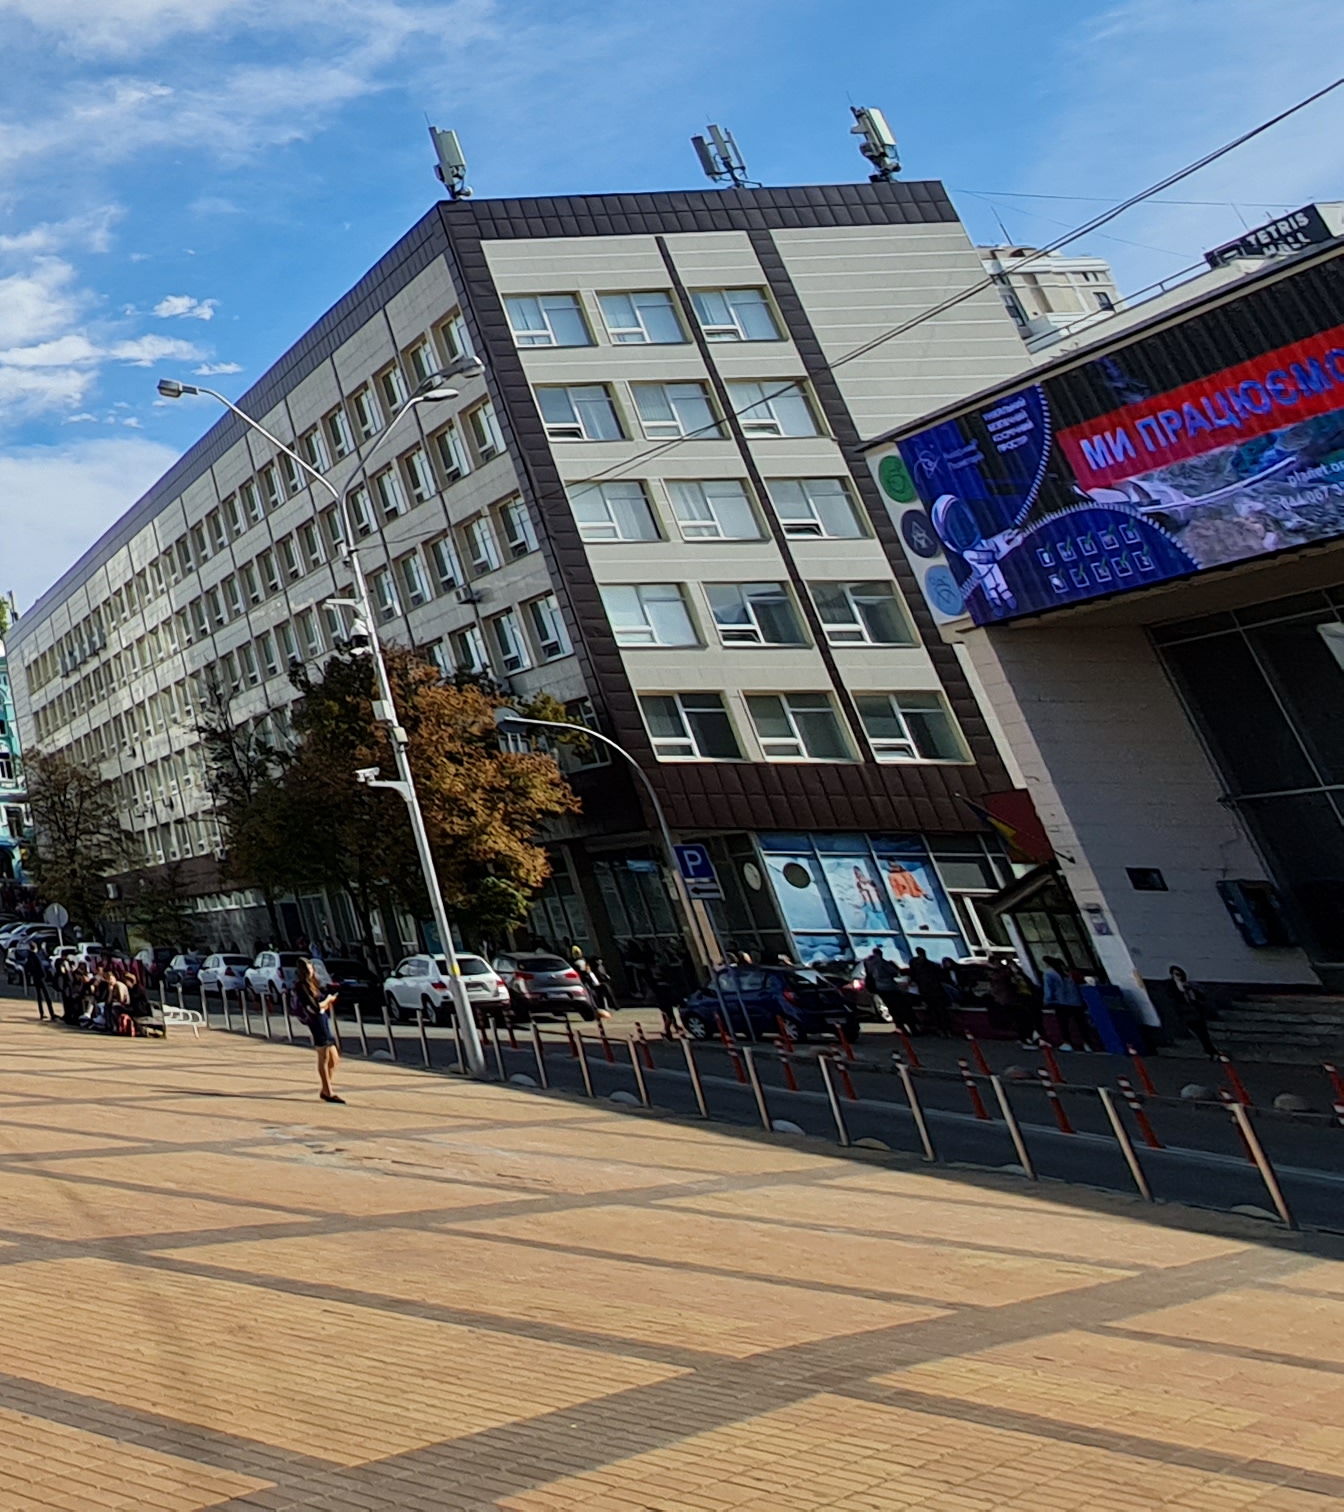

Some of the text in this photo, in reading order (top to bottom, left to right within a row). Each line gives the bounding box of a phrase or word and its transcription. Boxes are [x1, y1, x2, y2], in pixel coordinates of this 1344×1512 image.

[1246, 212, 1310, 247] TETRIS
[1079, 427, 1137, 471] МИ
[683, 850, 702, 876] P
